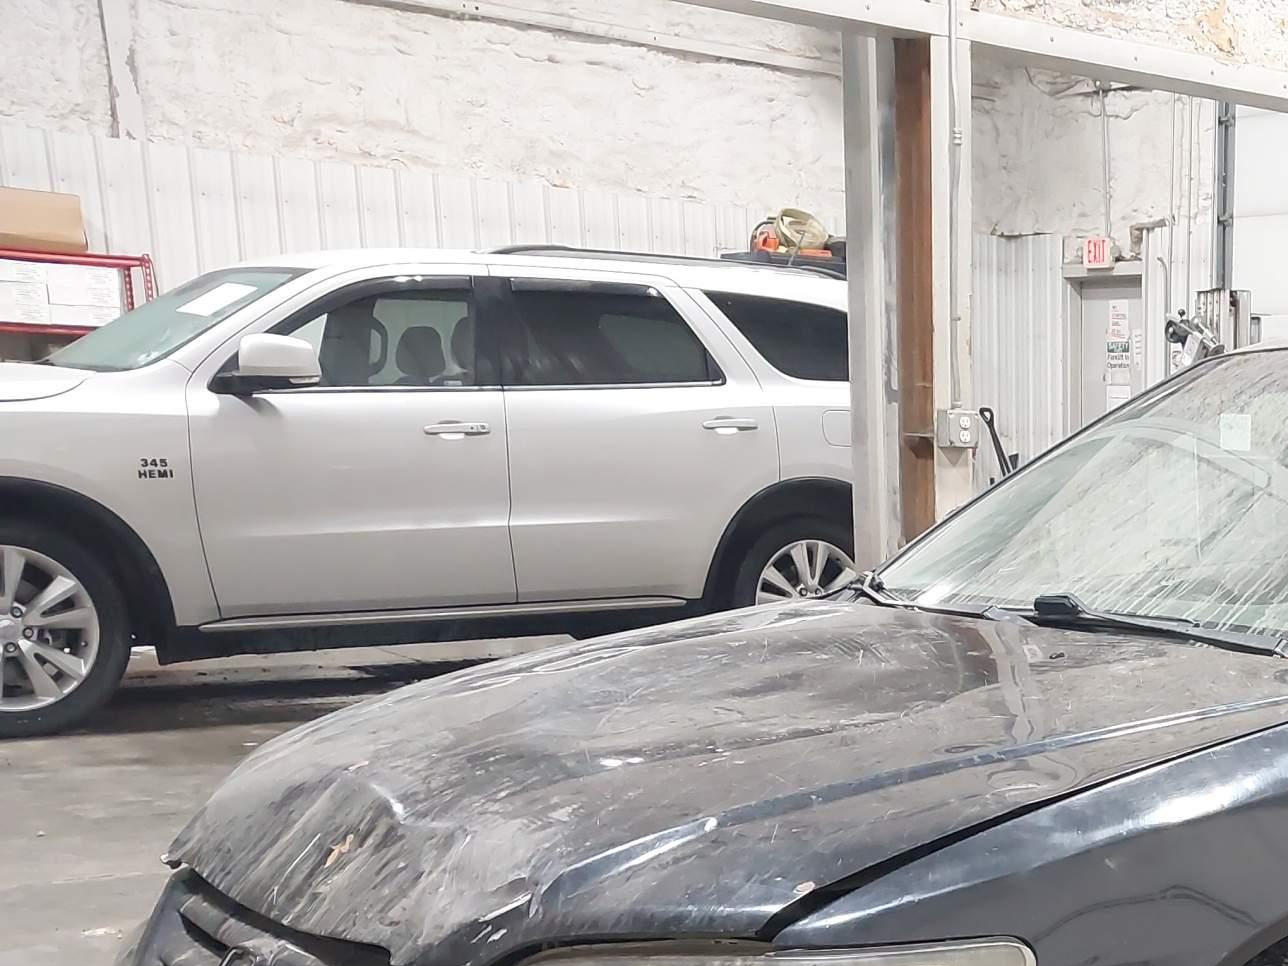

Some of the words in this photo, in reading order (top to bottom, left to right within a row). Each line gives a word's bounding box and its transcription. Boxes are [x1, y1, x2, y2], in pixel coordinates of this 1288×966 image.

[1087, 239, 1106, 264] EXIT
[140, 458, 168, 467] 345
[137, 469, 174, 479] HEMI
